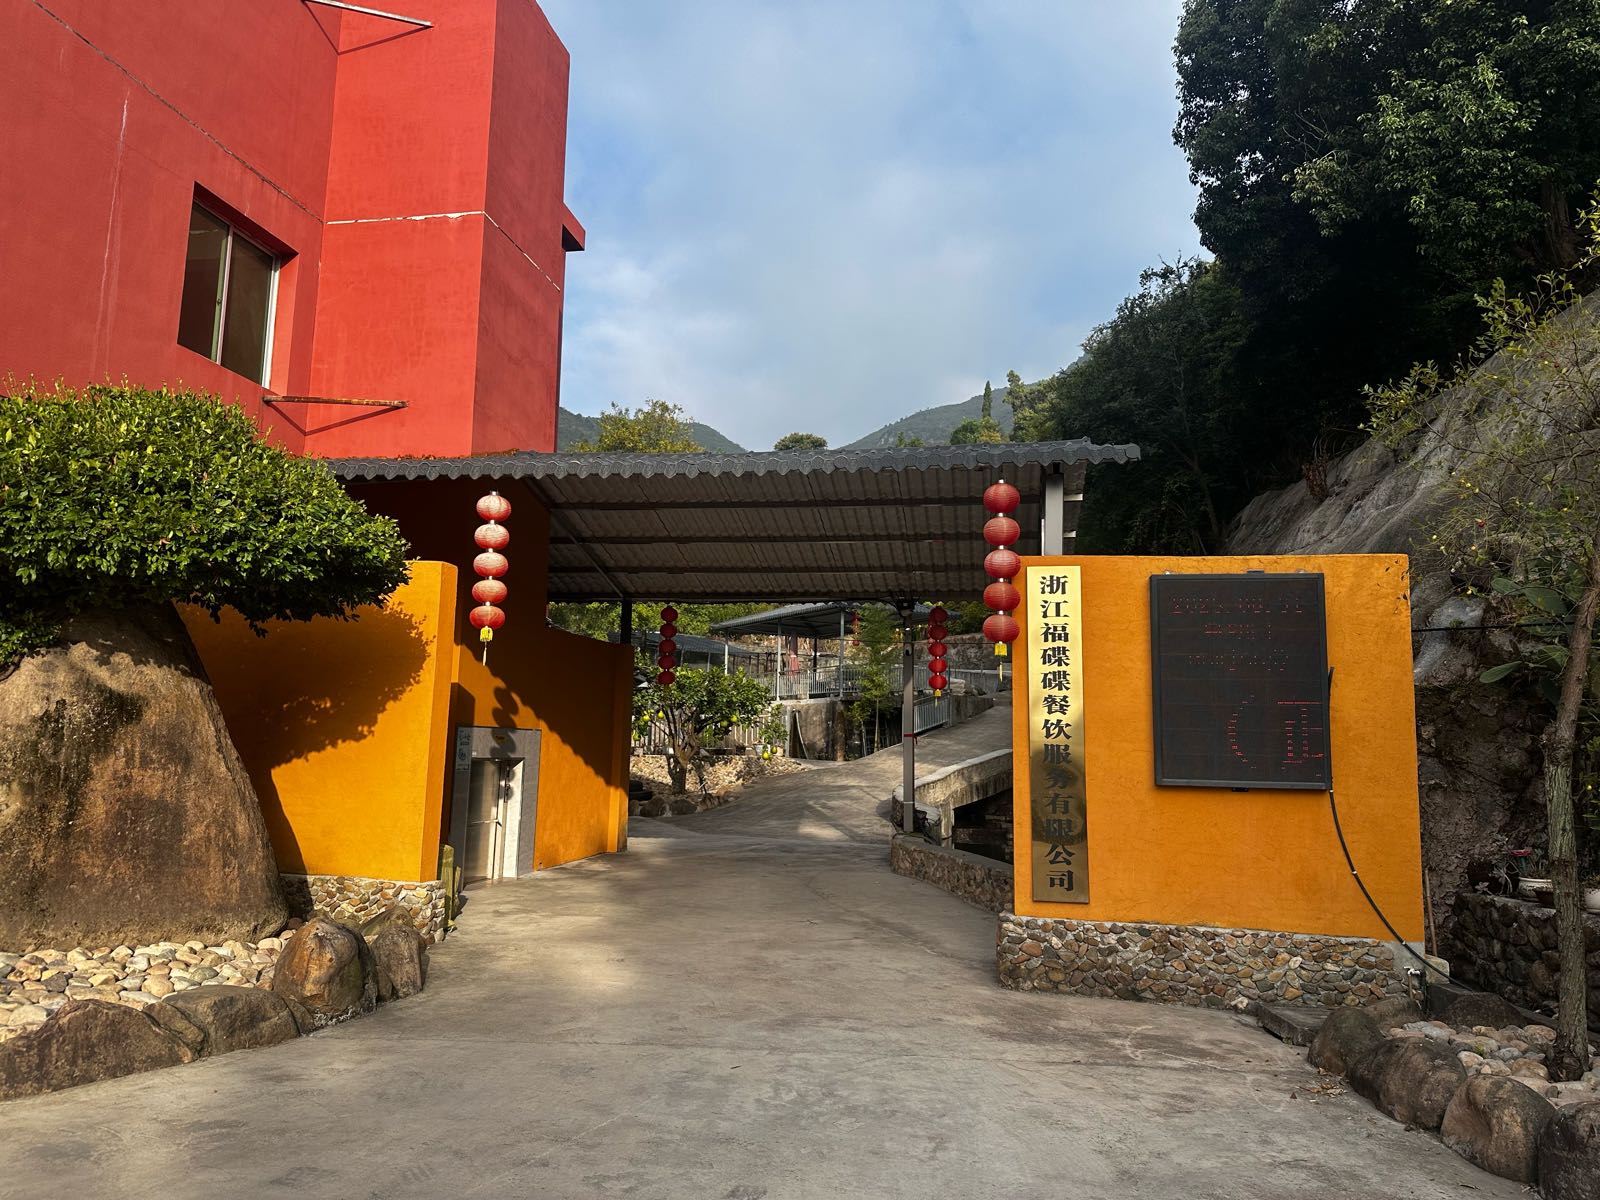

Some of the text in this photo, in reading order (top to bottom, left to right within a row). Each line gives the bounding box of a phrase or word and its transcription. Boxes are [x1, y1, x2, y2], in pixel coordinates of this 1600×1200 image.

[1040, 575, 1075, 892] 浙江福碟碟餐饮服务有限公司
